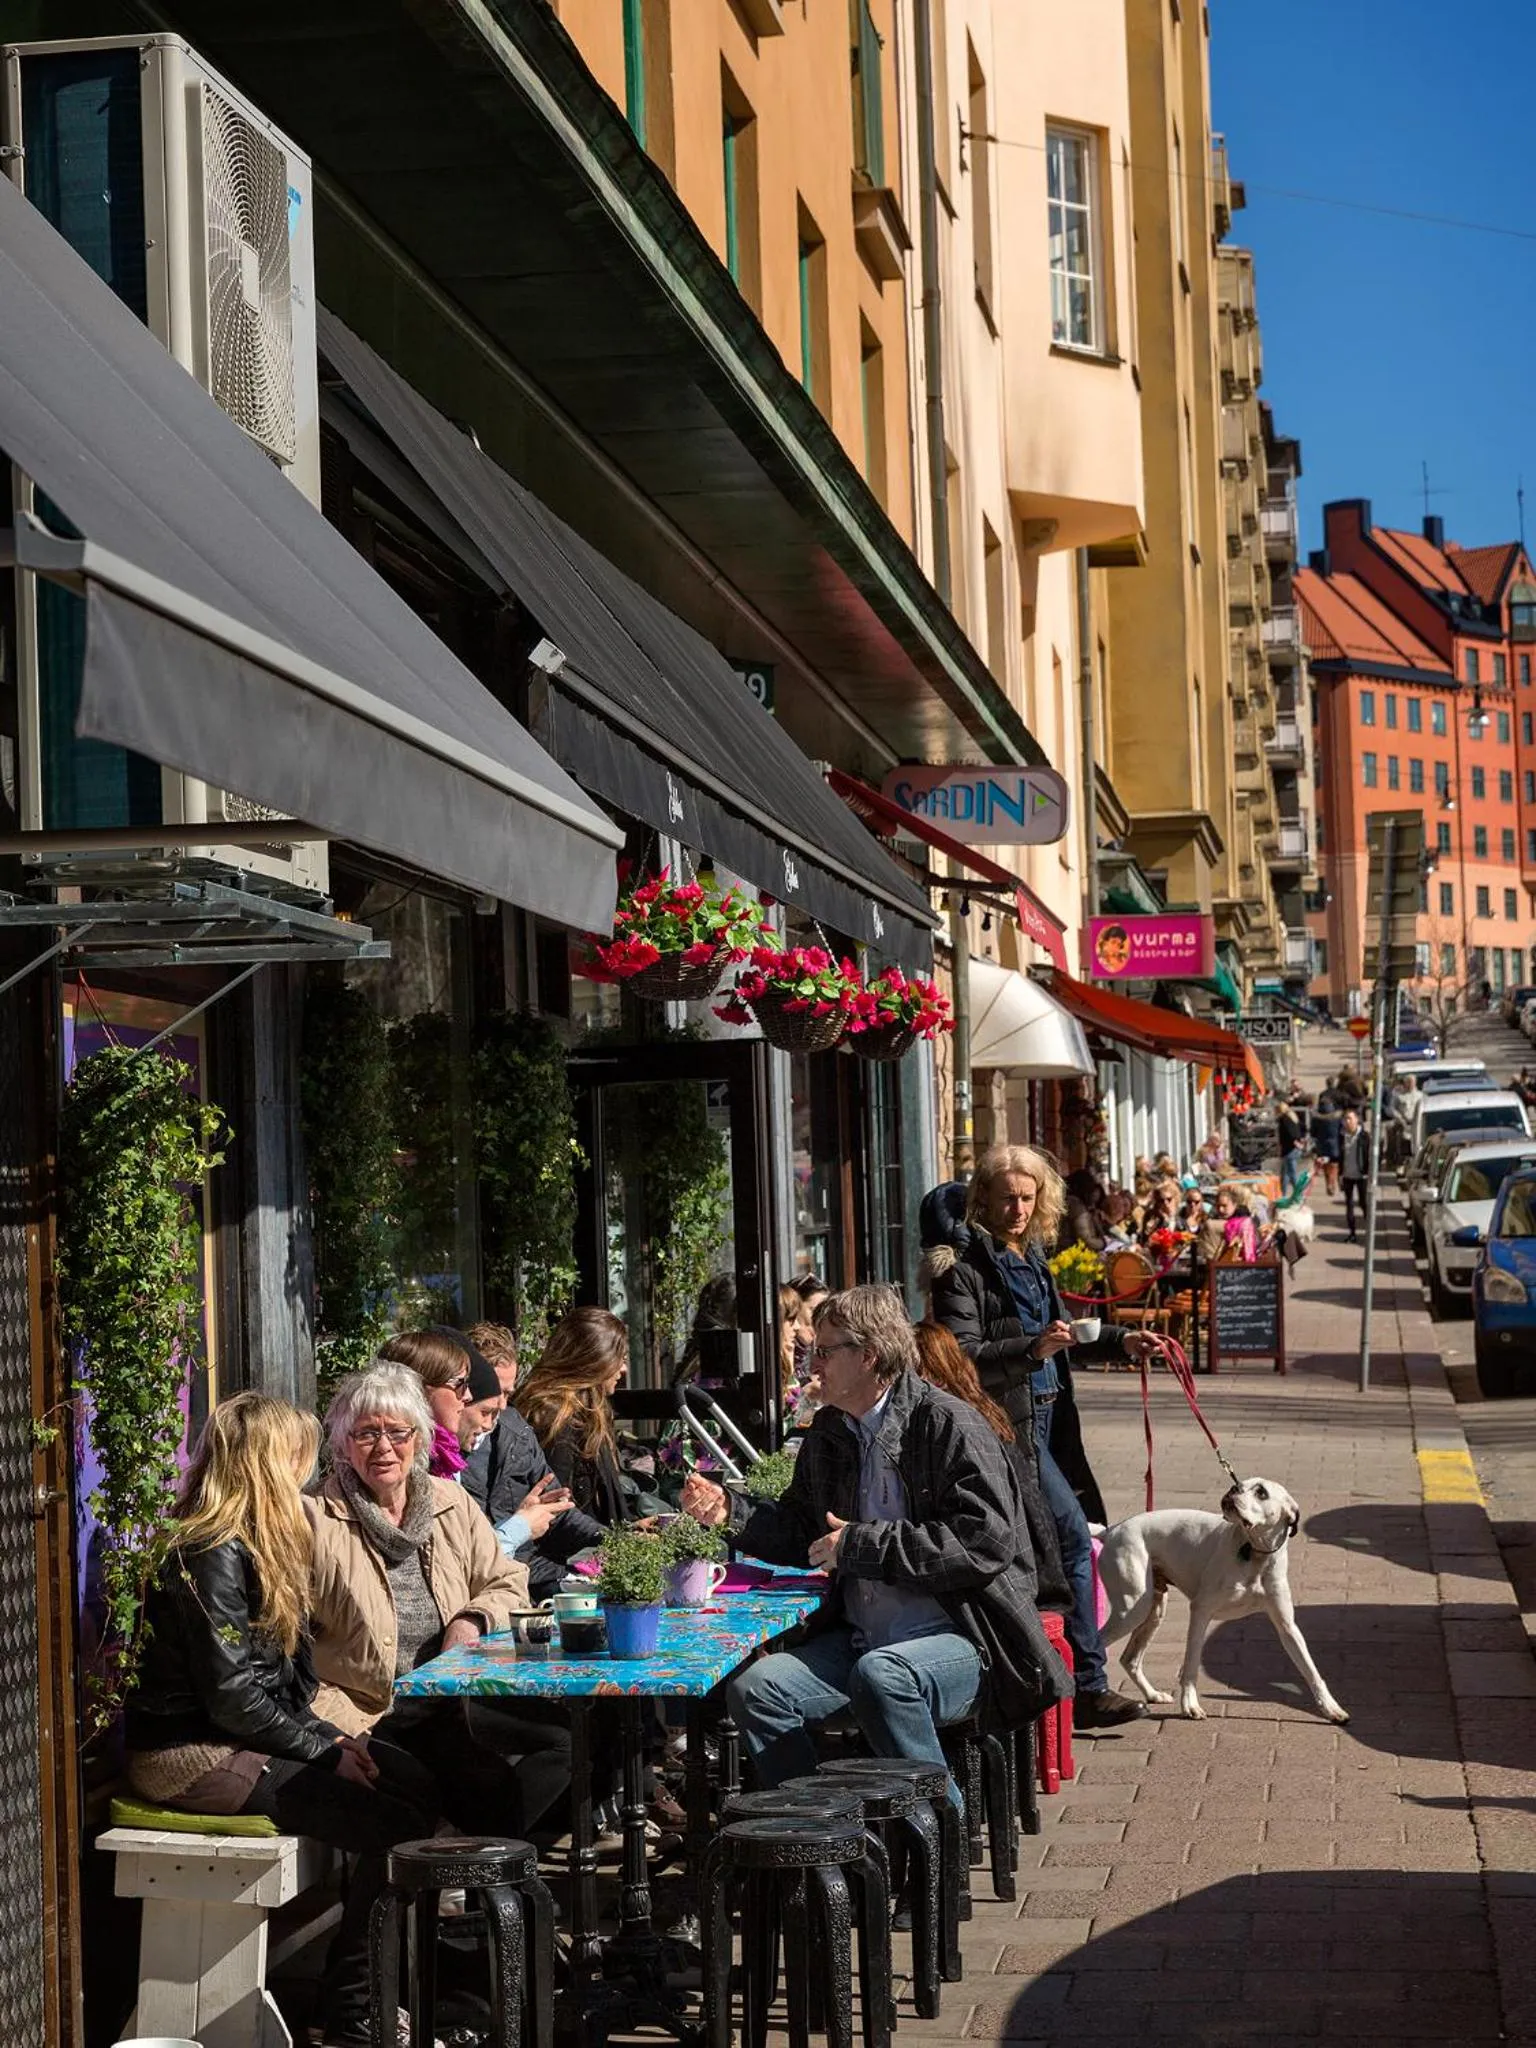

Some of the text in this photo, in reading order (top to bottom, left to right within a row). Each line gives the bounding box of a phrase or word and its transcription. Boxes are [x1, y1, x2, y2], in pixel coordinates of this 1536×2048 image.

[1132, 932, 1196, 947] vurma
[1133, 949, 1169, 958] bistro
[1178, 948, 1196, 957] bar
